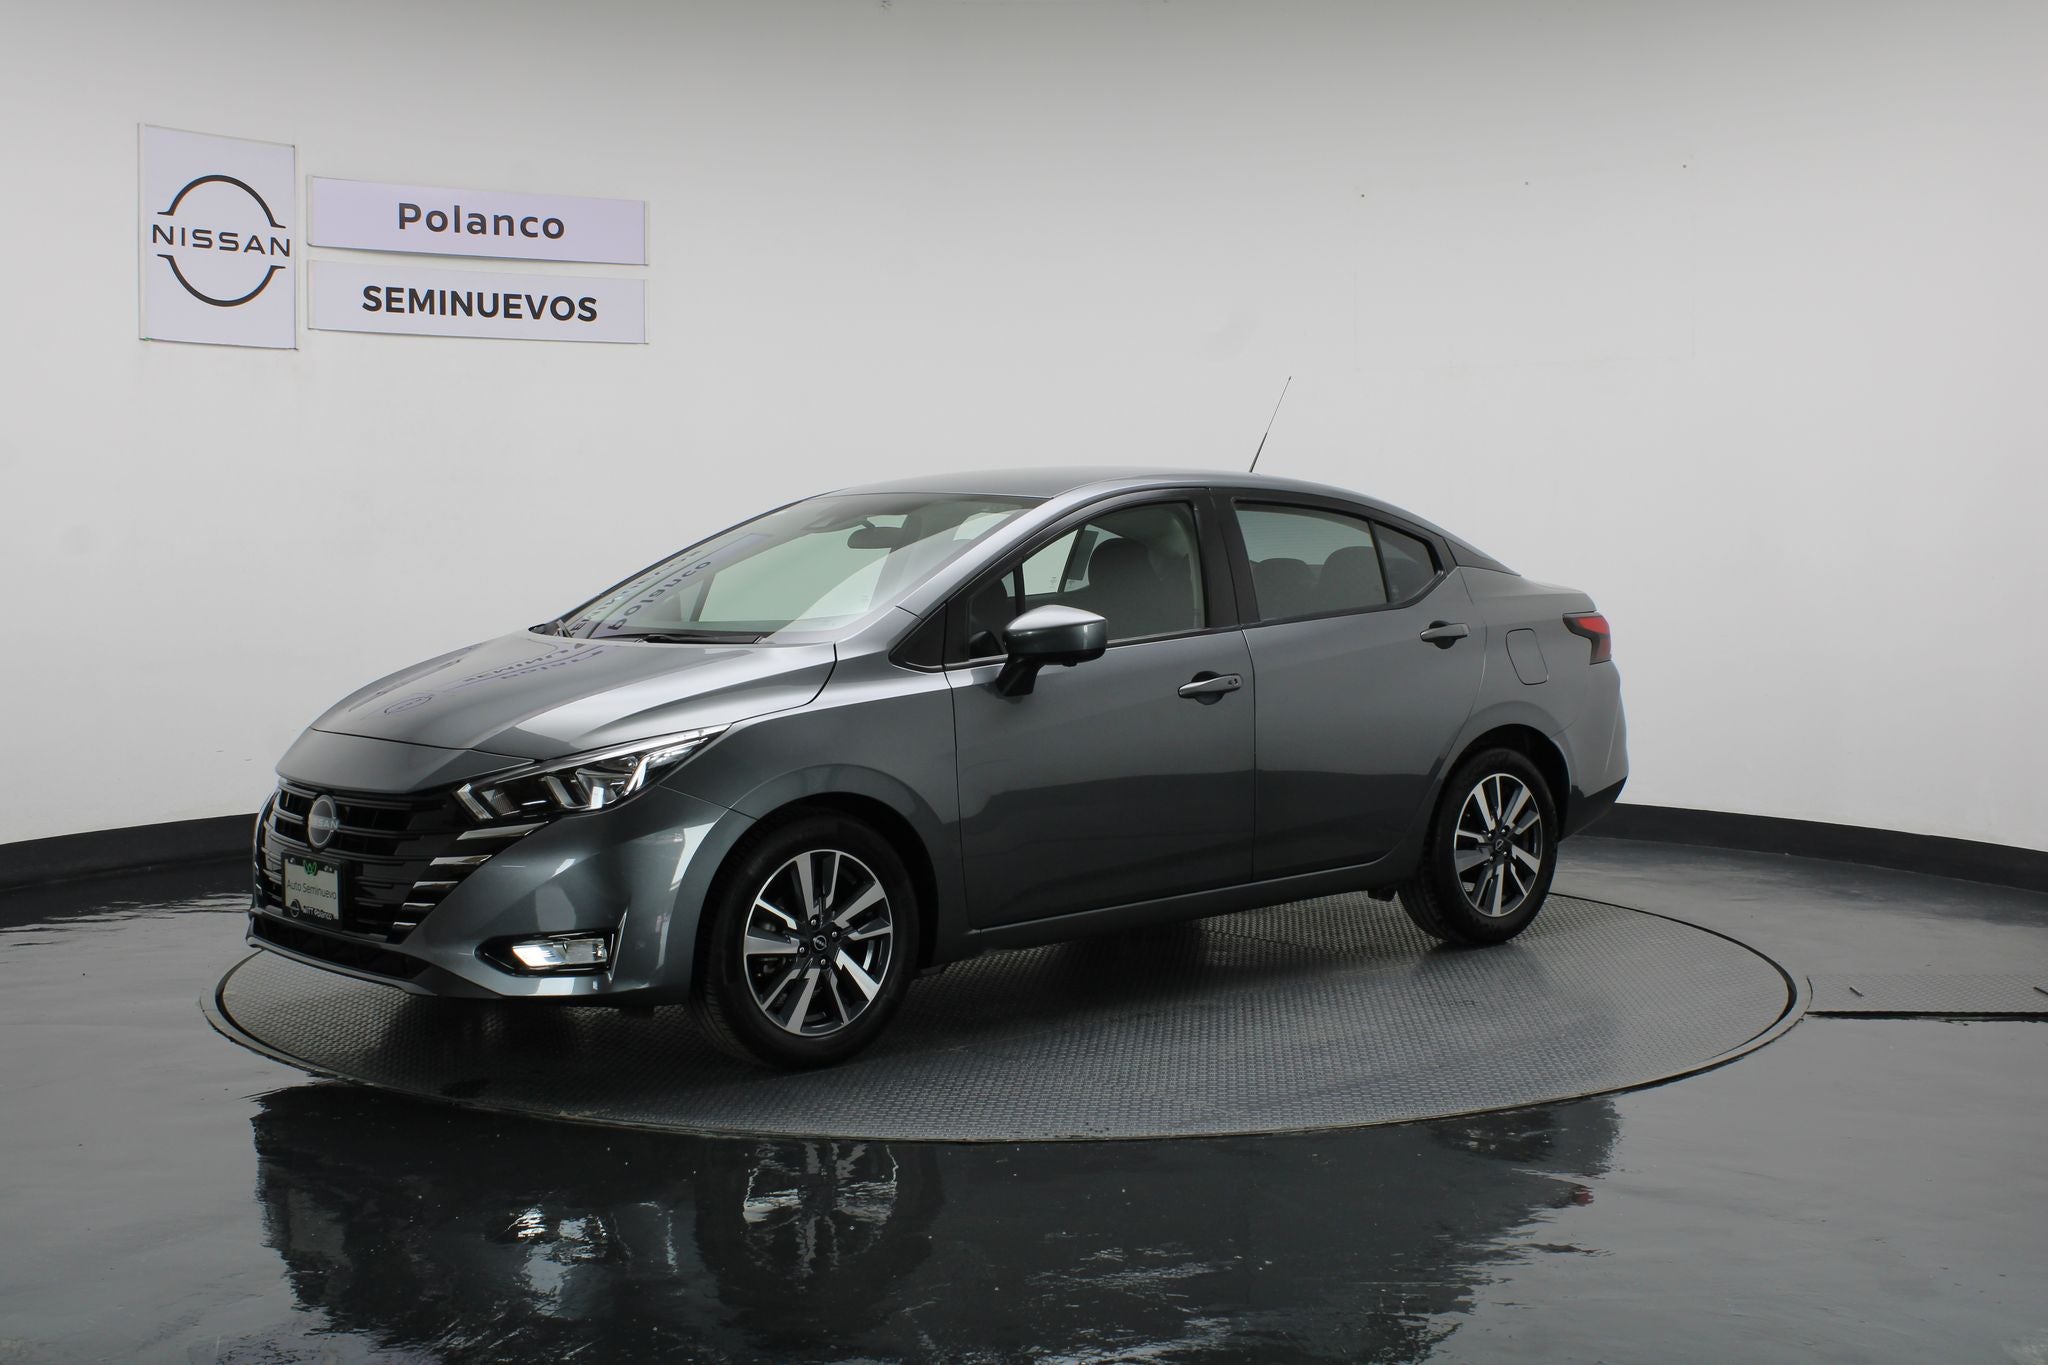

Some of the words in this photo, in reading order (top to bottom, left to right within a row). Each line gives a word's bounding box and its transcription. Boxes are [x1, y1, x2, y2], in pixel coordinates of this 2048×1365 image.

[398, 203, 566, 240] Polanco
[153, 225, 291, 257] NISSAN
[362, 285, 599, 322] SEMINUEVOS
